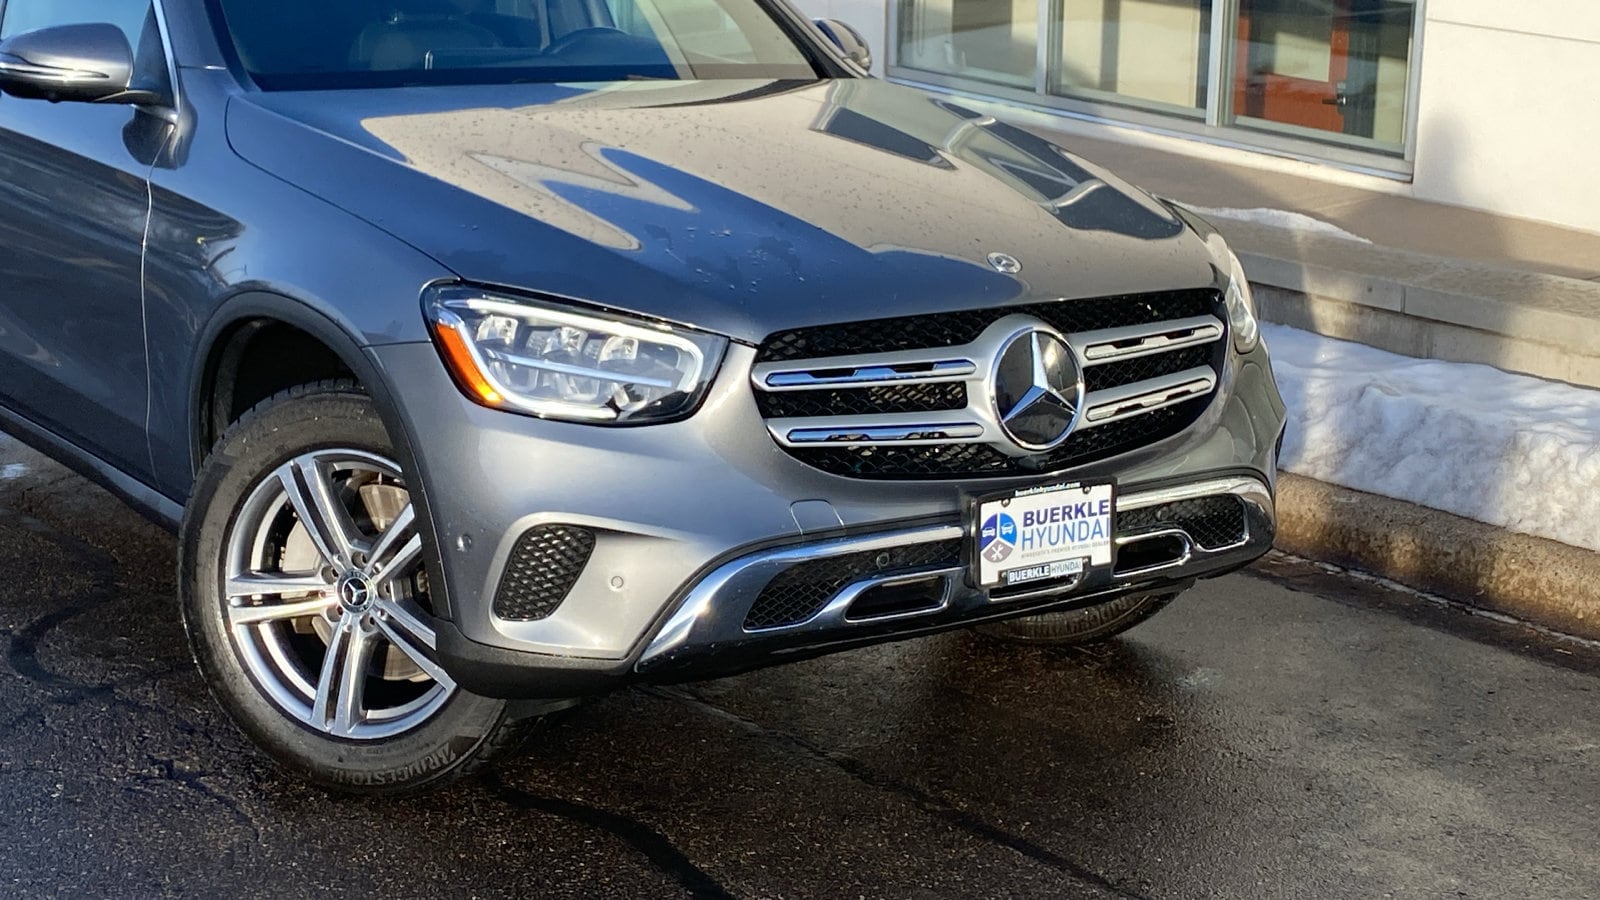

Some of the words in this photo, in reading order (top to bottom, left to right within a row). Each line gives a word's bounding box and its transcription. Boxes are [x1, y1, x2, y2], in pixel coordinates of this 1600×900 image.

[1023, 499, 1109, 527] BUERKLE
[1021, 517, 1110, 551] HYUNDAI
[1009, 565, 1050, 582] BUERKLE
